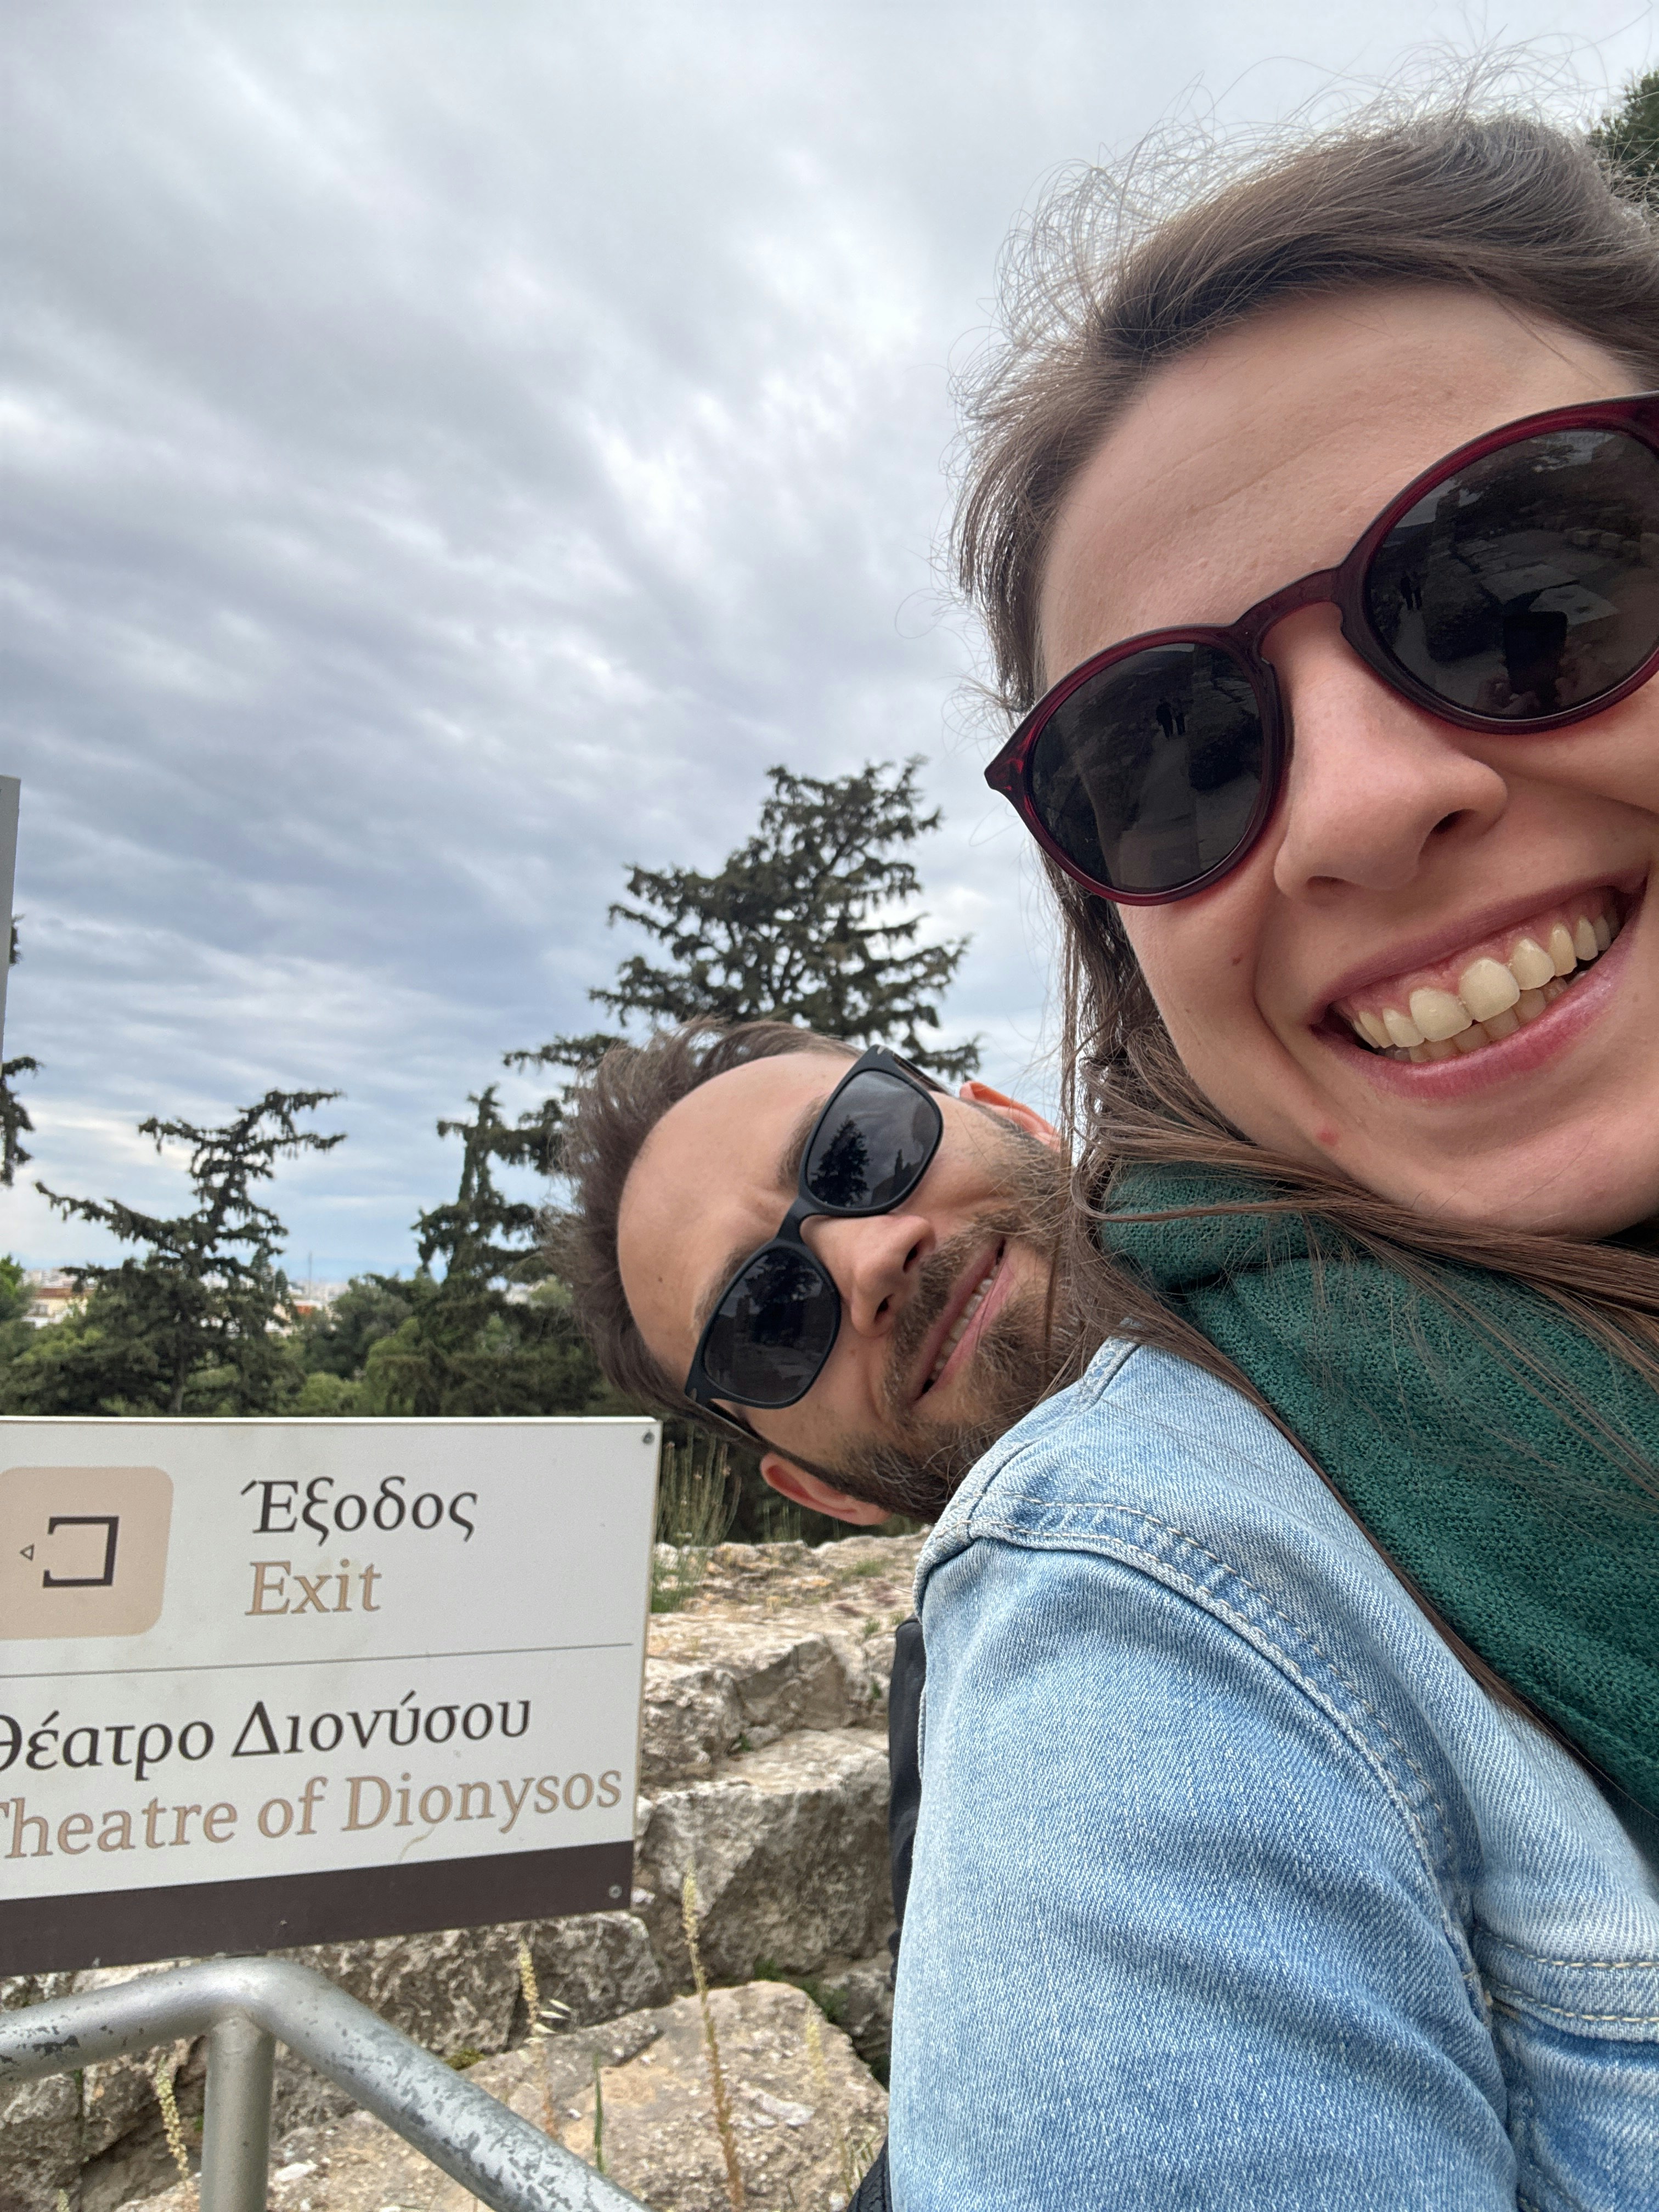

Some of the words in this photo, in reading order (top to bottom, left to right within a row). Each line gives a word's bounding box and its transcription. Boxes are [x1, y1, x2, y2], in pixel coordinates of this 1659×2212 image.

[241, 1475, 478, 1547] Έξοδος
[244, 1558, 382, 1616] Exit
[230, 1690, 532, 1758] Διονύσου
[0, 1797, 238, 1859] heatre
[258, 1776, 328, 1838] of
[340, 1769, 622, 1834] Dionysos
